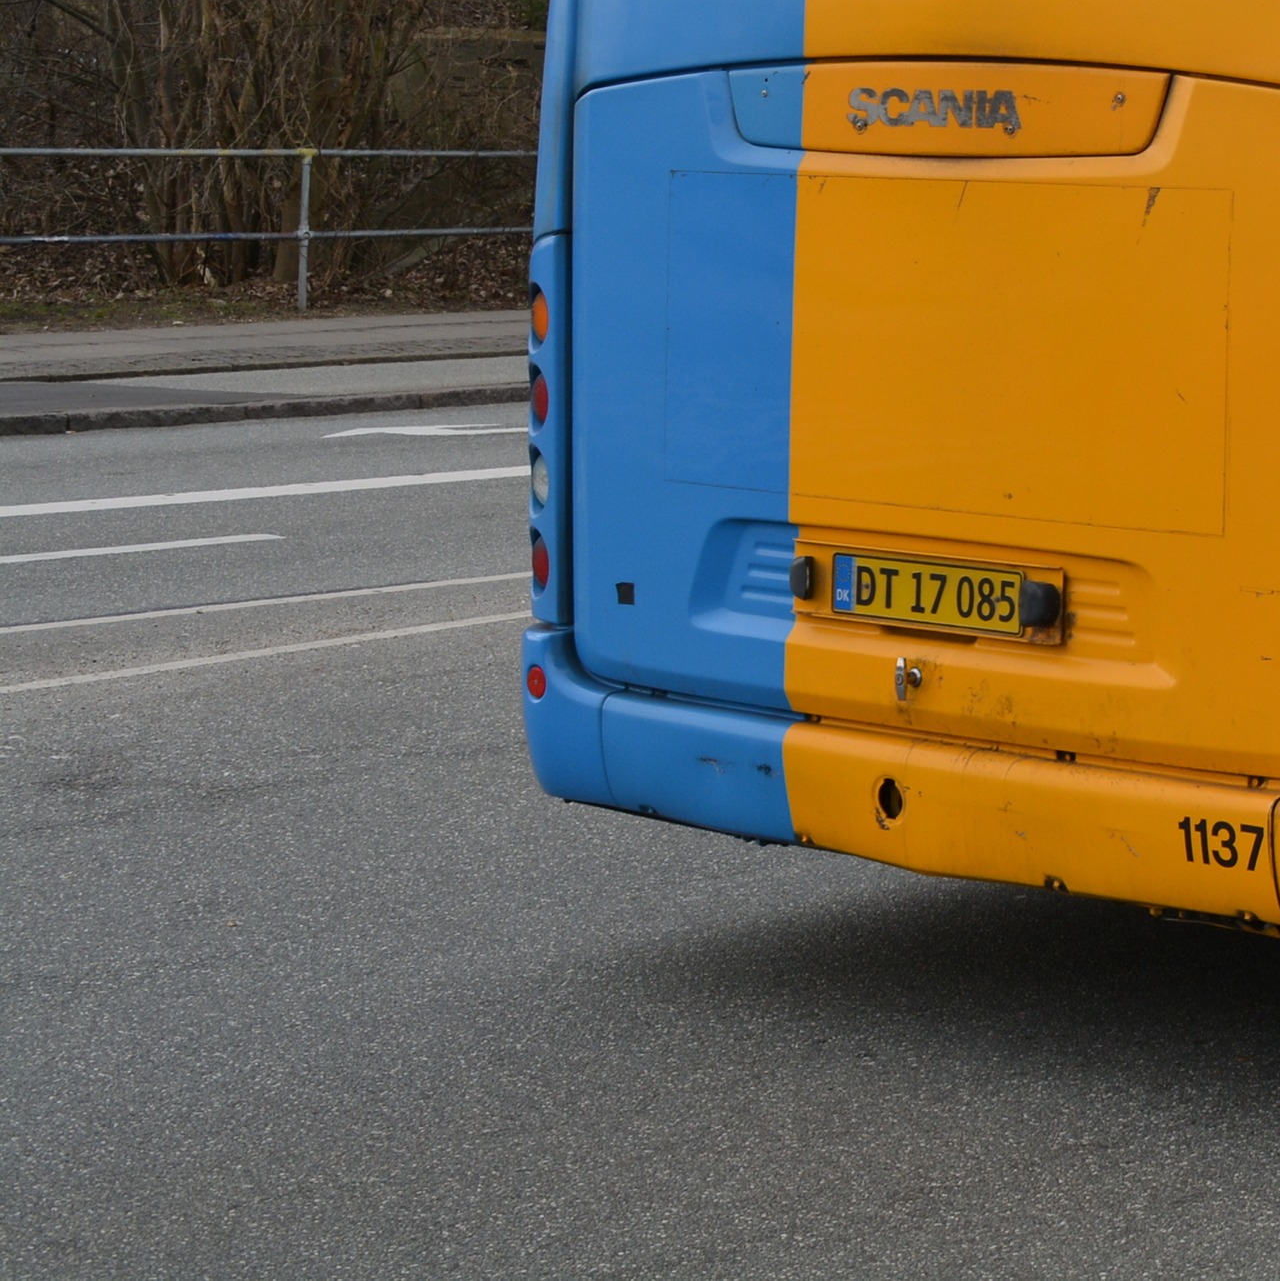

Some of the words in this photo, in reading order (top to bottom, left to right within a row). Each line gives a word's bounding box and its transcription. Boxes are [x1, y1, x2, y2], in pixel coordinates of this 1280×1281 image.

[846, 87, 1022, 130] SCANIA
[836, 588, 850, 602] DK
[855, 565, 899, 609] DT
[910, 571, 947, 614] 17
[956, 576, 1016, 622] 085
[1178, 816, 1264, 872] 1137
